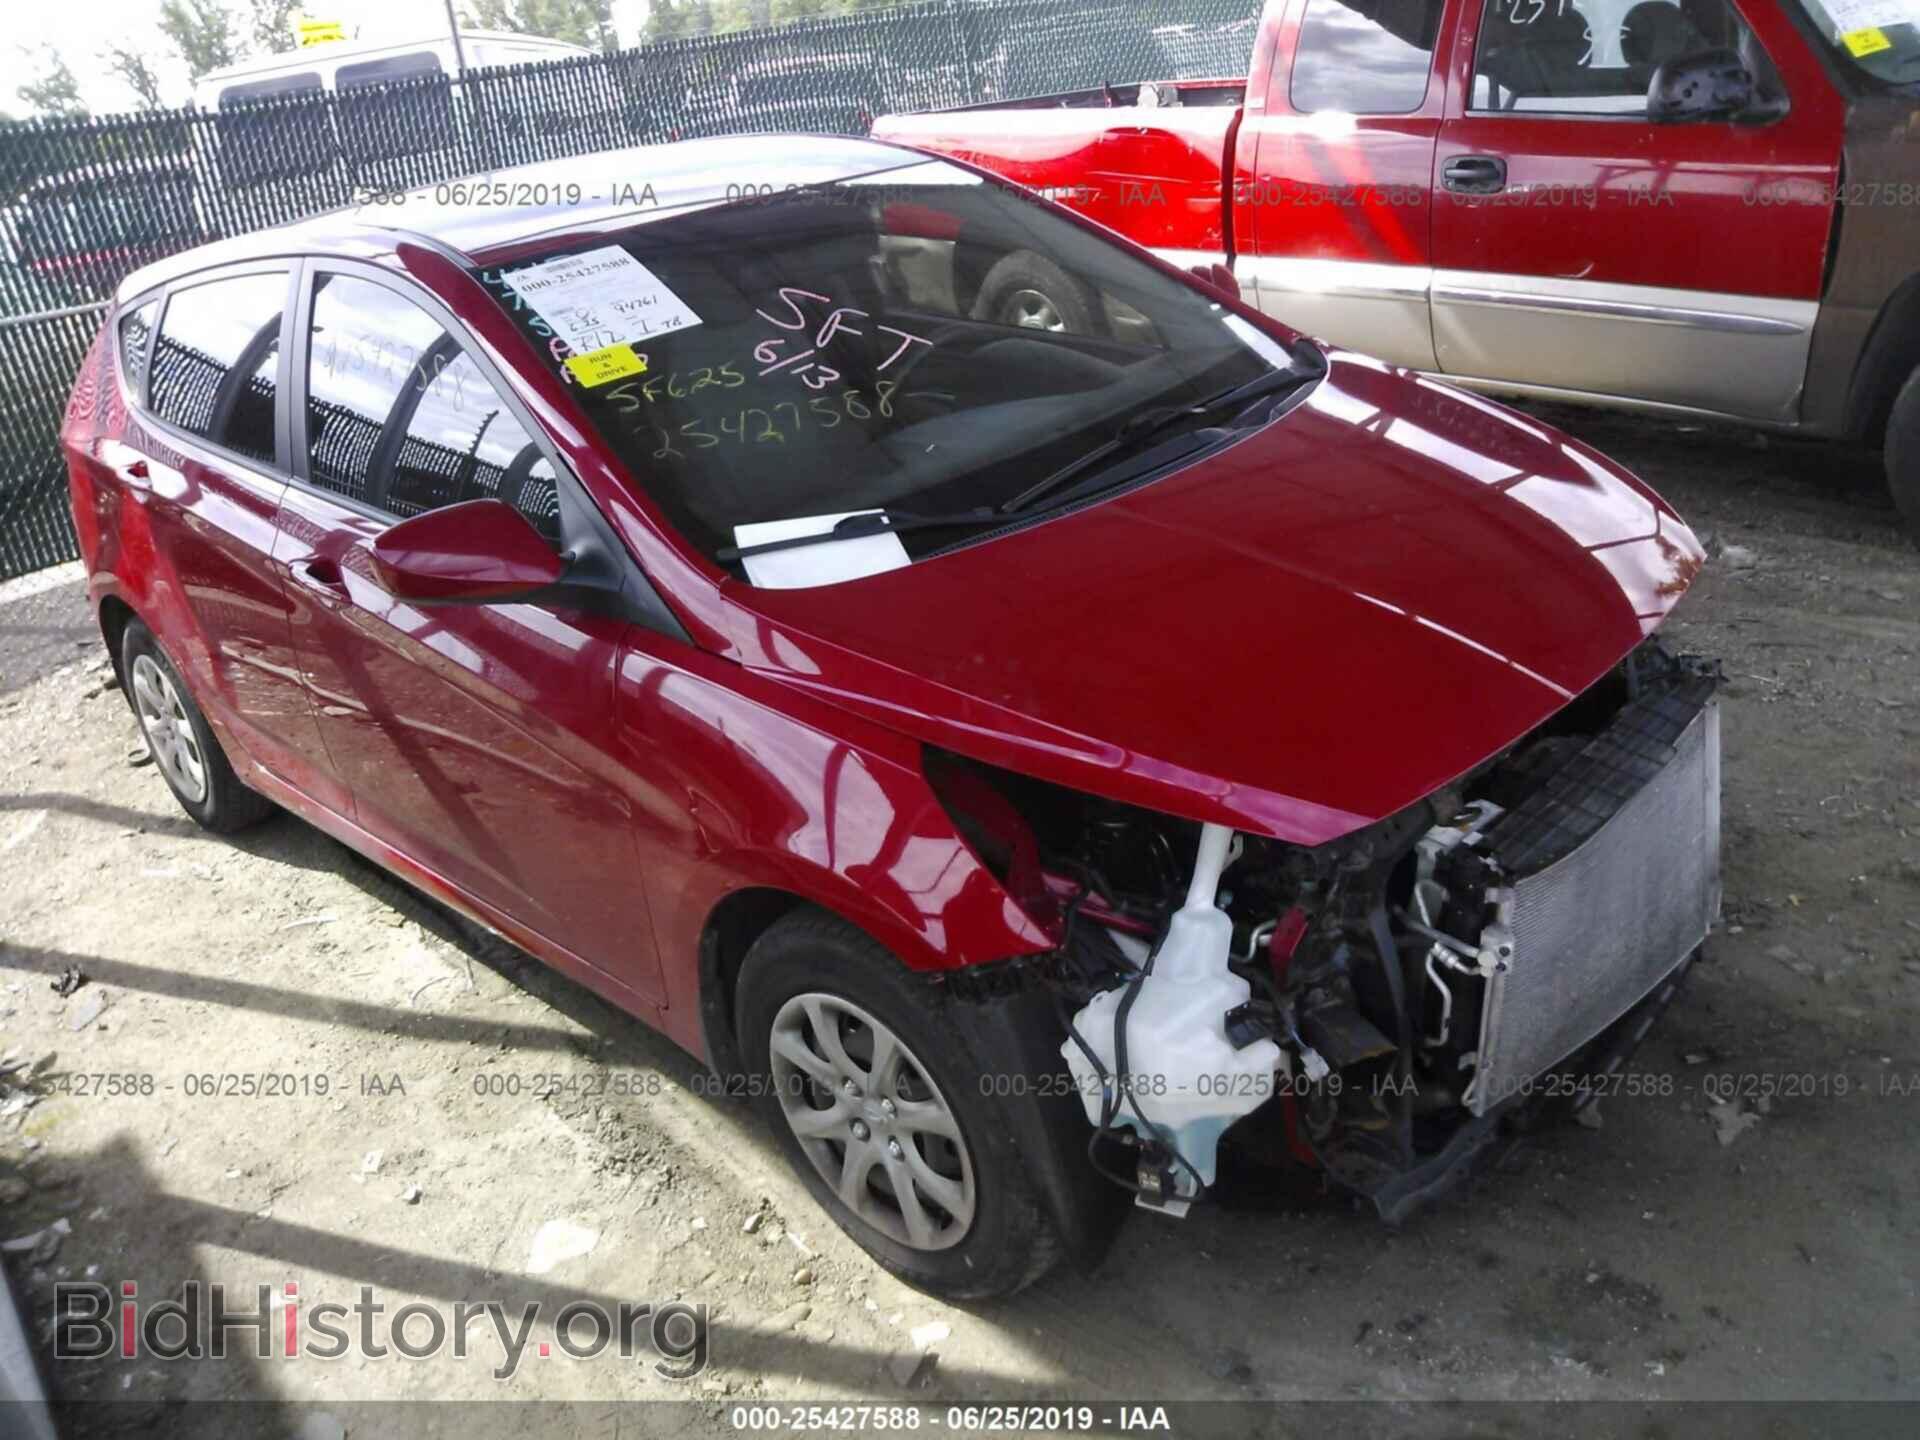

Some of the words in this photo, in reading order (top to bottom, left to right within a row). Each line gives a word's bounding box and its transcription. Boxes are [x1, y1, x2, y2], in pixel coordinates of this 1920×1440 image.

[756, 287, 934, 371] SFT
[589, 353, 613, 364] RUN
[753, 338, 841, 389] 6/13
[605, 361, 745, 414] SF625
[631, 379, 898, 459] 25427588
